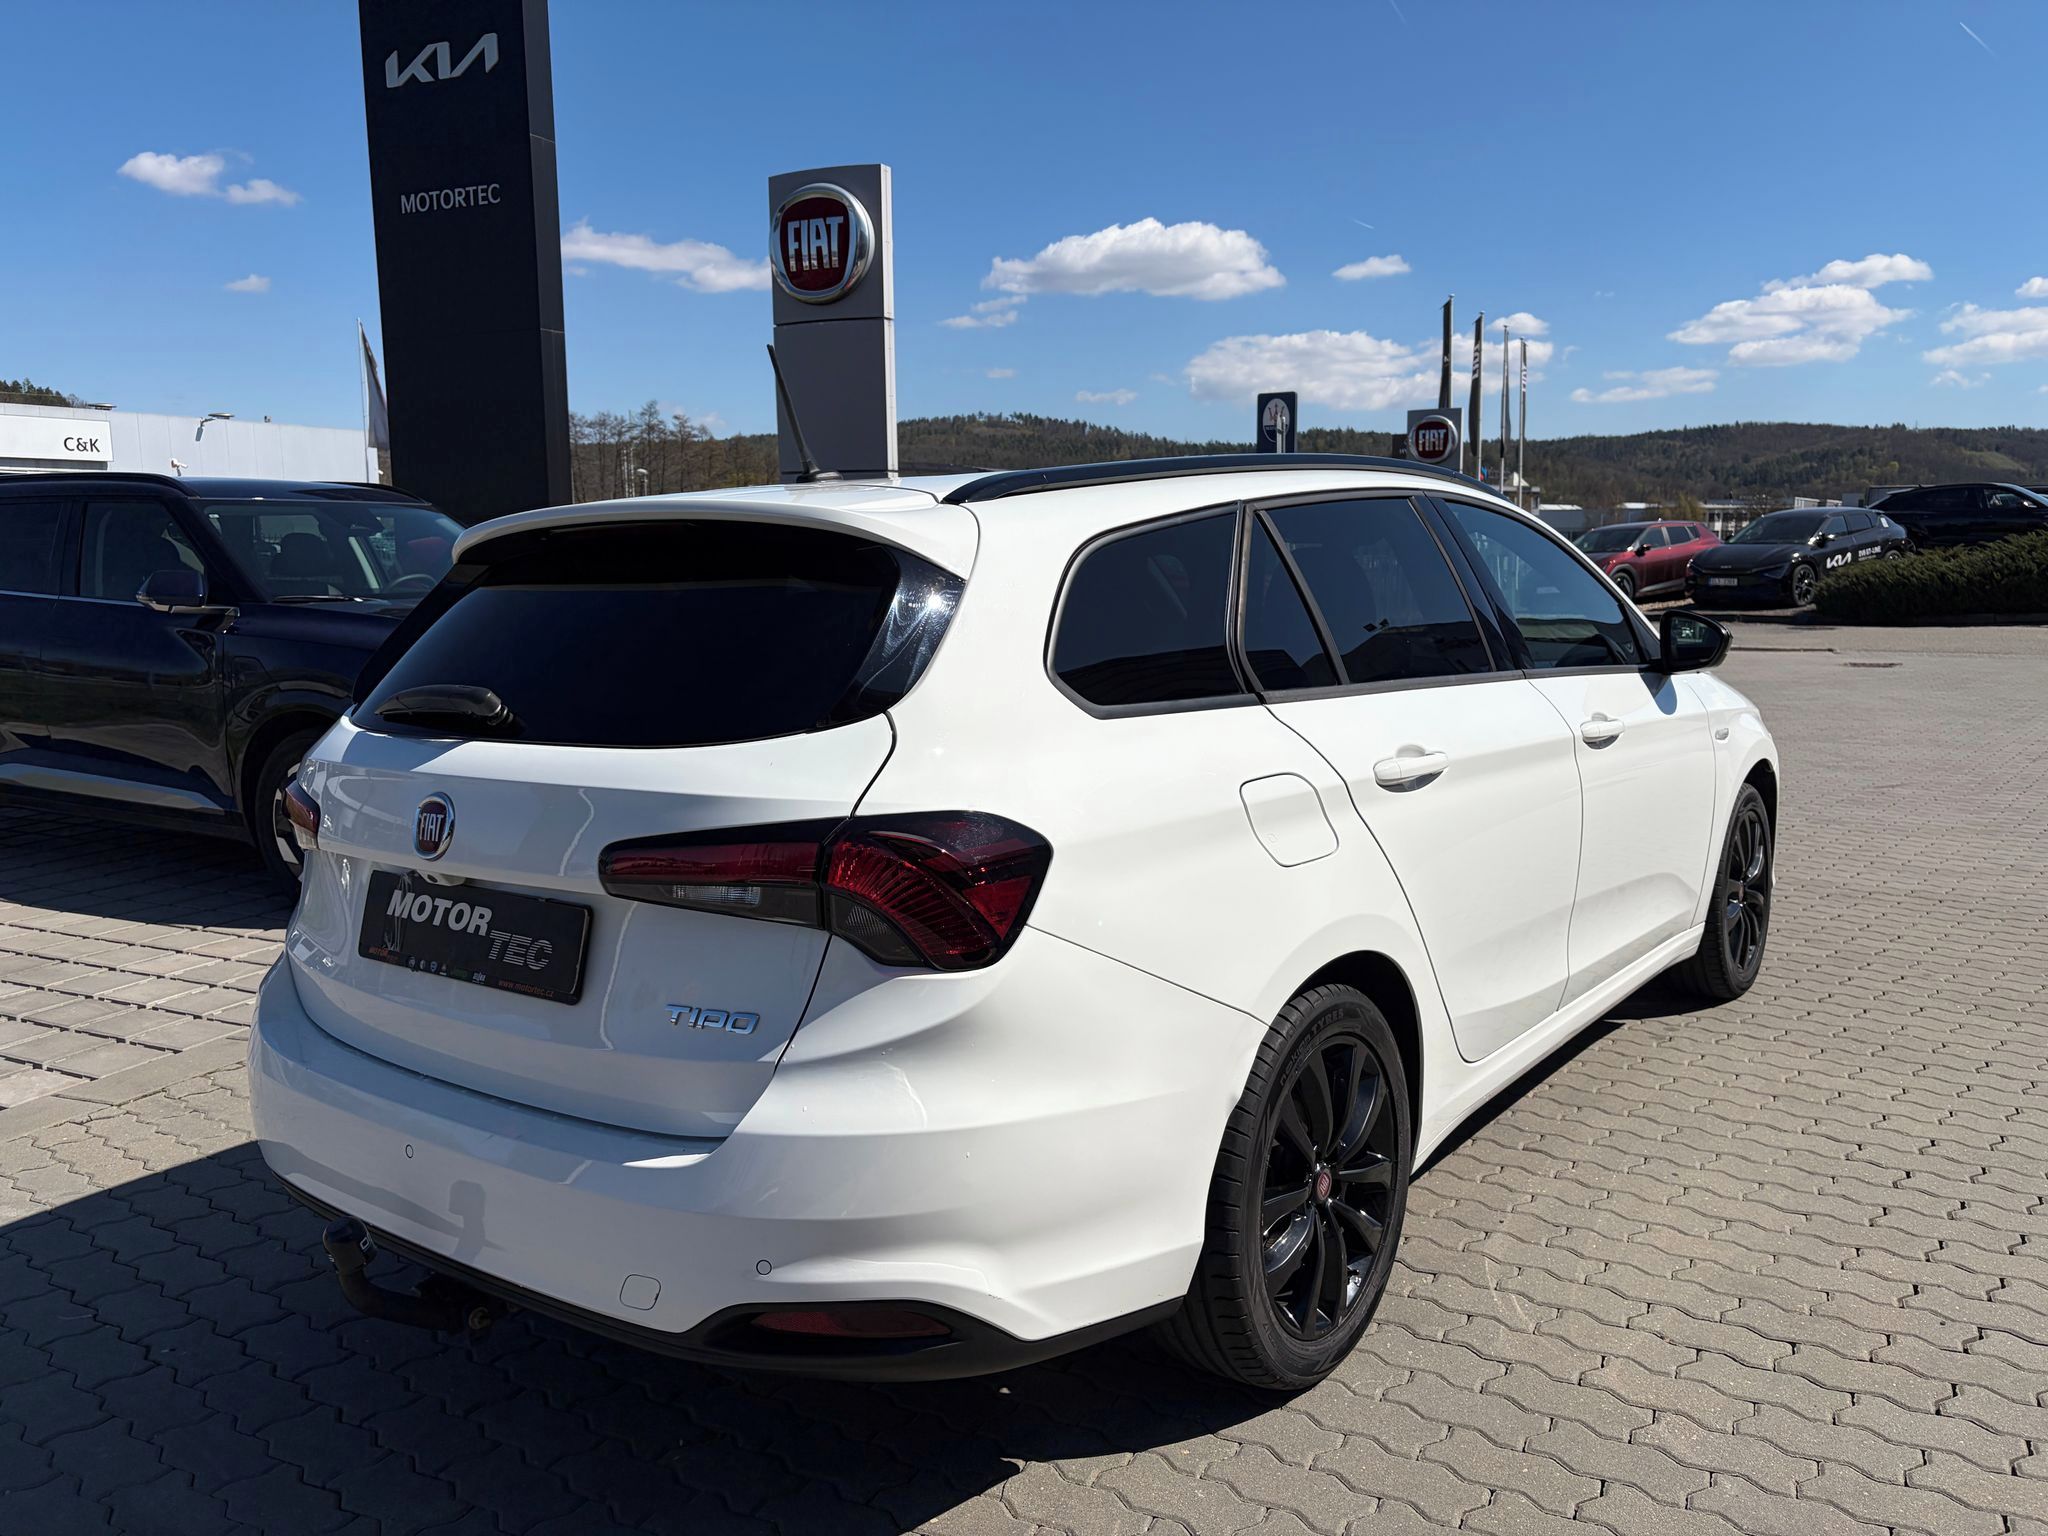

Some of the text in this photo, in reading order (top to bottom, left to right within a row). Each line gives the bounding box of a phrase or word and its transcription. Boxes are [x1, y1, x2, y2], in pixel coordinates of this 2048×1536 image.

[385, 33, 499, 88] KIA
[401, 184, 501, 214] MOTORTEC
[787, 216, 844, 272] FIAT
[63, 437, 101, 453] C&K
[1418, 428, 1447, 452] FIAT
[1826, 552, 1852, 569] KIA
[420, 812, 445, 842] FIAT
[386, 889, 493, 937] MOTOR
[487, 929, 553, 971] TEC
[664, 1004, 760, 1035] TIPO
